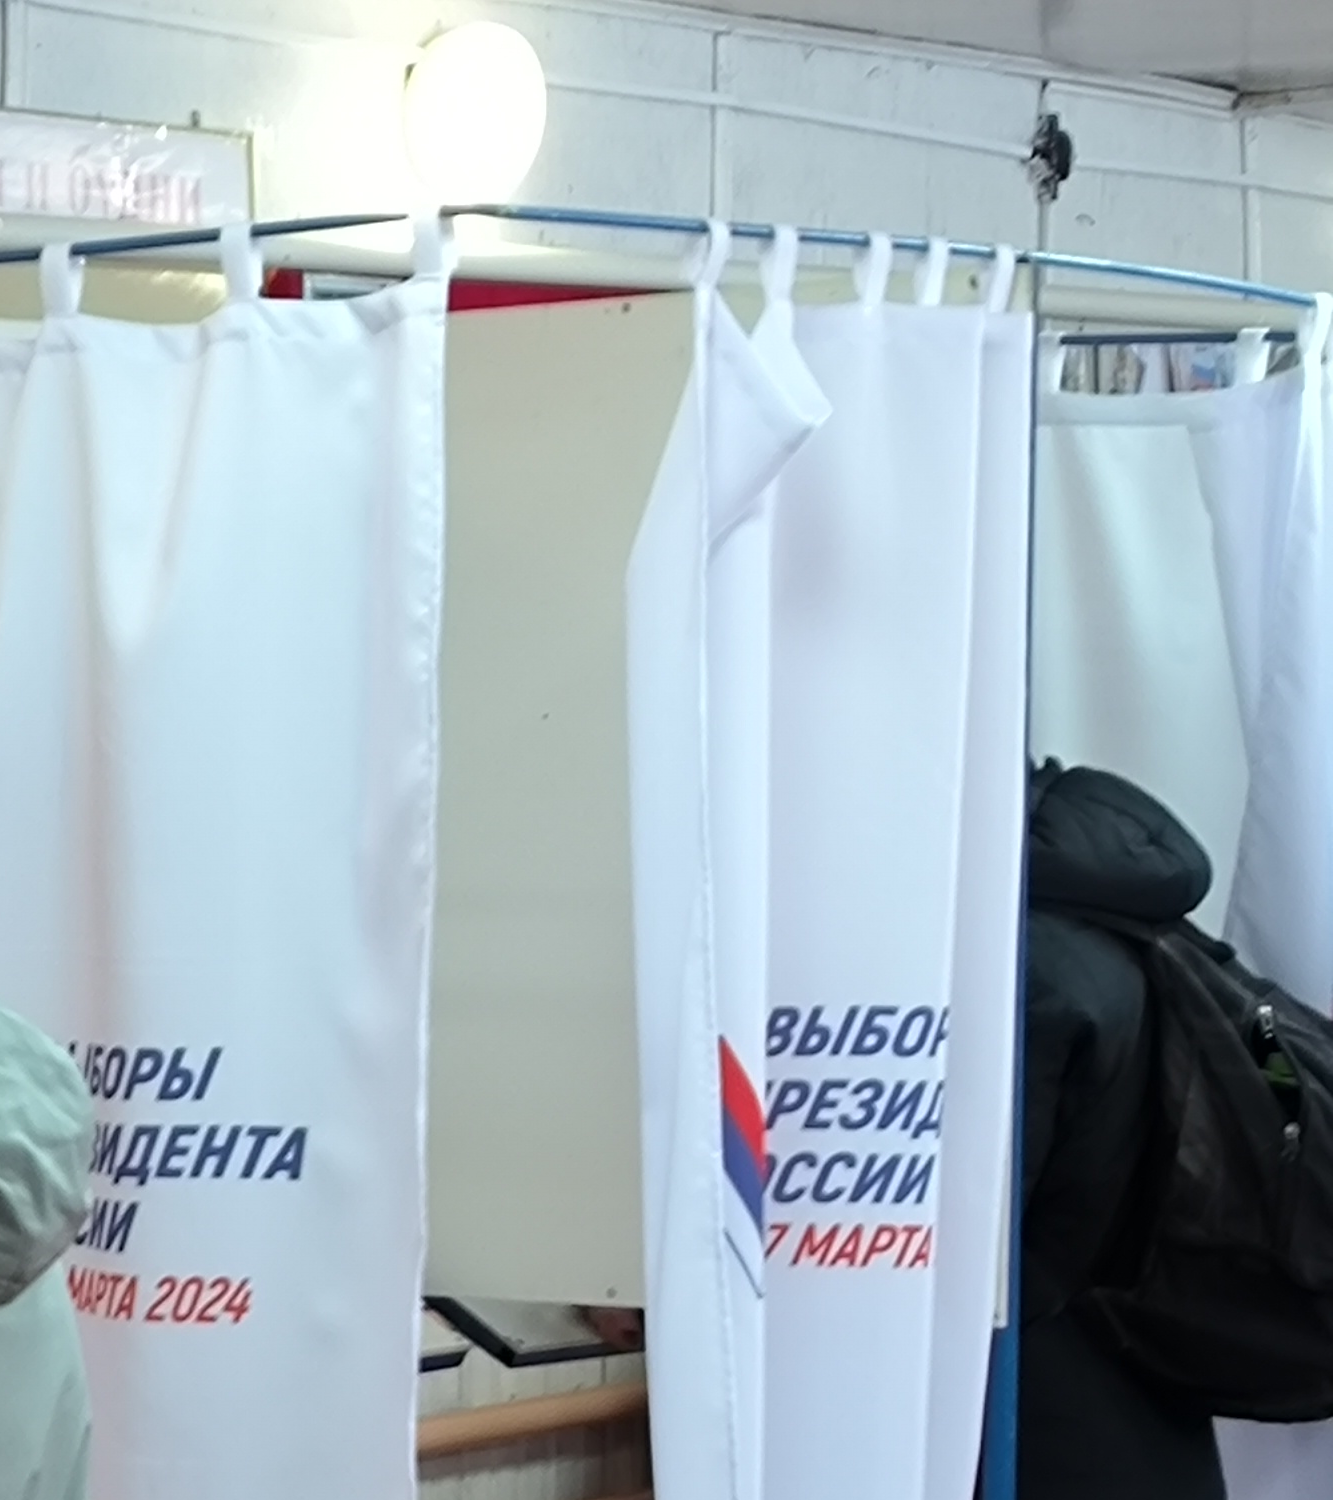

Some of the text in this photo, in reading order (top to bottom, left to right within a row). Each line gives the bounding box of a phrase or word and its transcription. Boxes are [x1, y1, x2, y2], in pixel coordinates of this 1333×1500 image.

[74, 1198, 139, 1252] ИИ
[764, 1223, 933, 1268] 7 МАРТА
[143, 1275, 253, 1324] 2024
